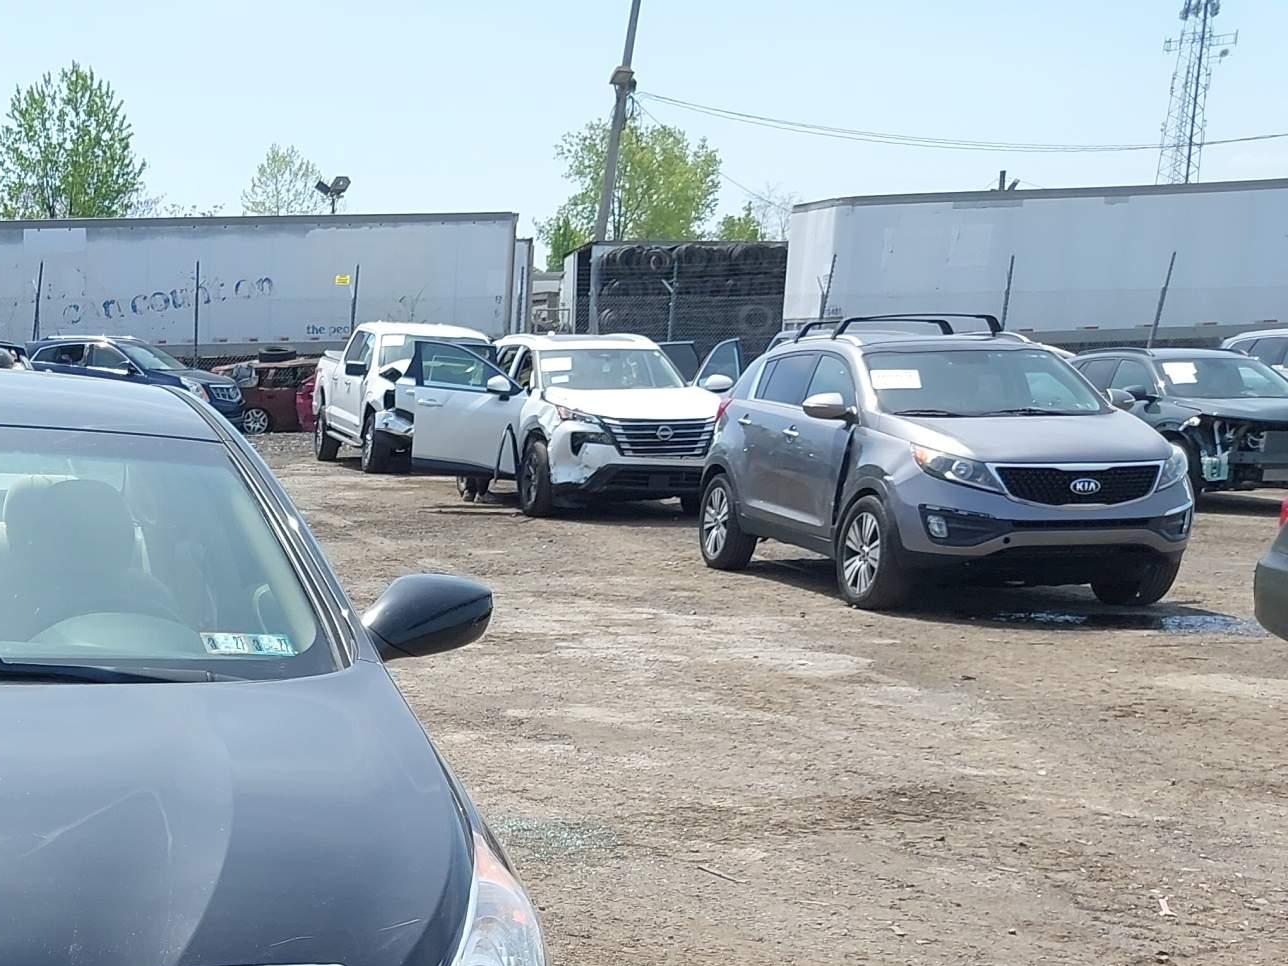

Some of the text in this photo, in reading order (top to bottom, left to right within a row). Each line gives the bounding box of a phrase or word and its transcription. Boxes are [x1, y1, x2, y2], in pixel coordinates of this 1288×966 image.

[306, 324, 352, 337] the peo
[1076, 482, 1096, 491] KIA
